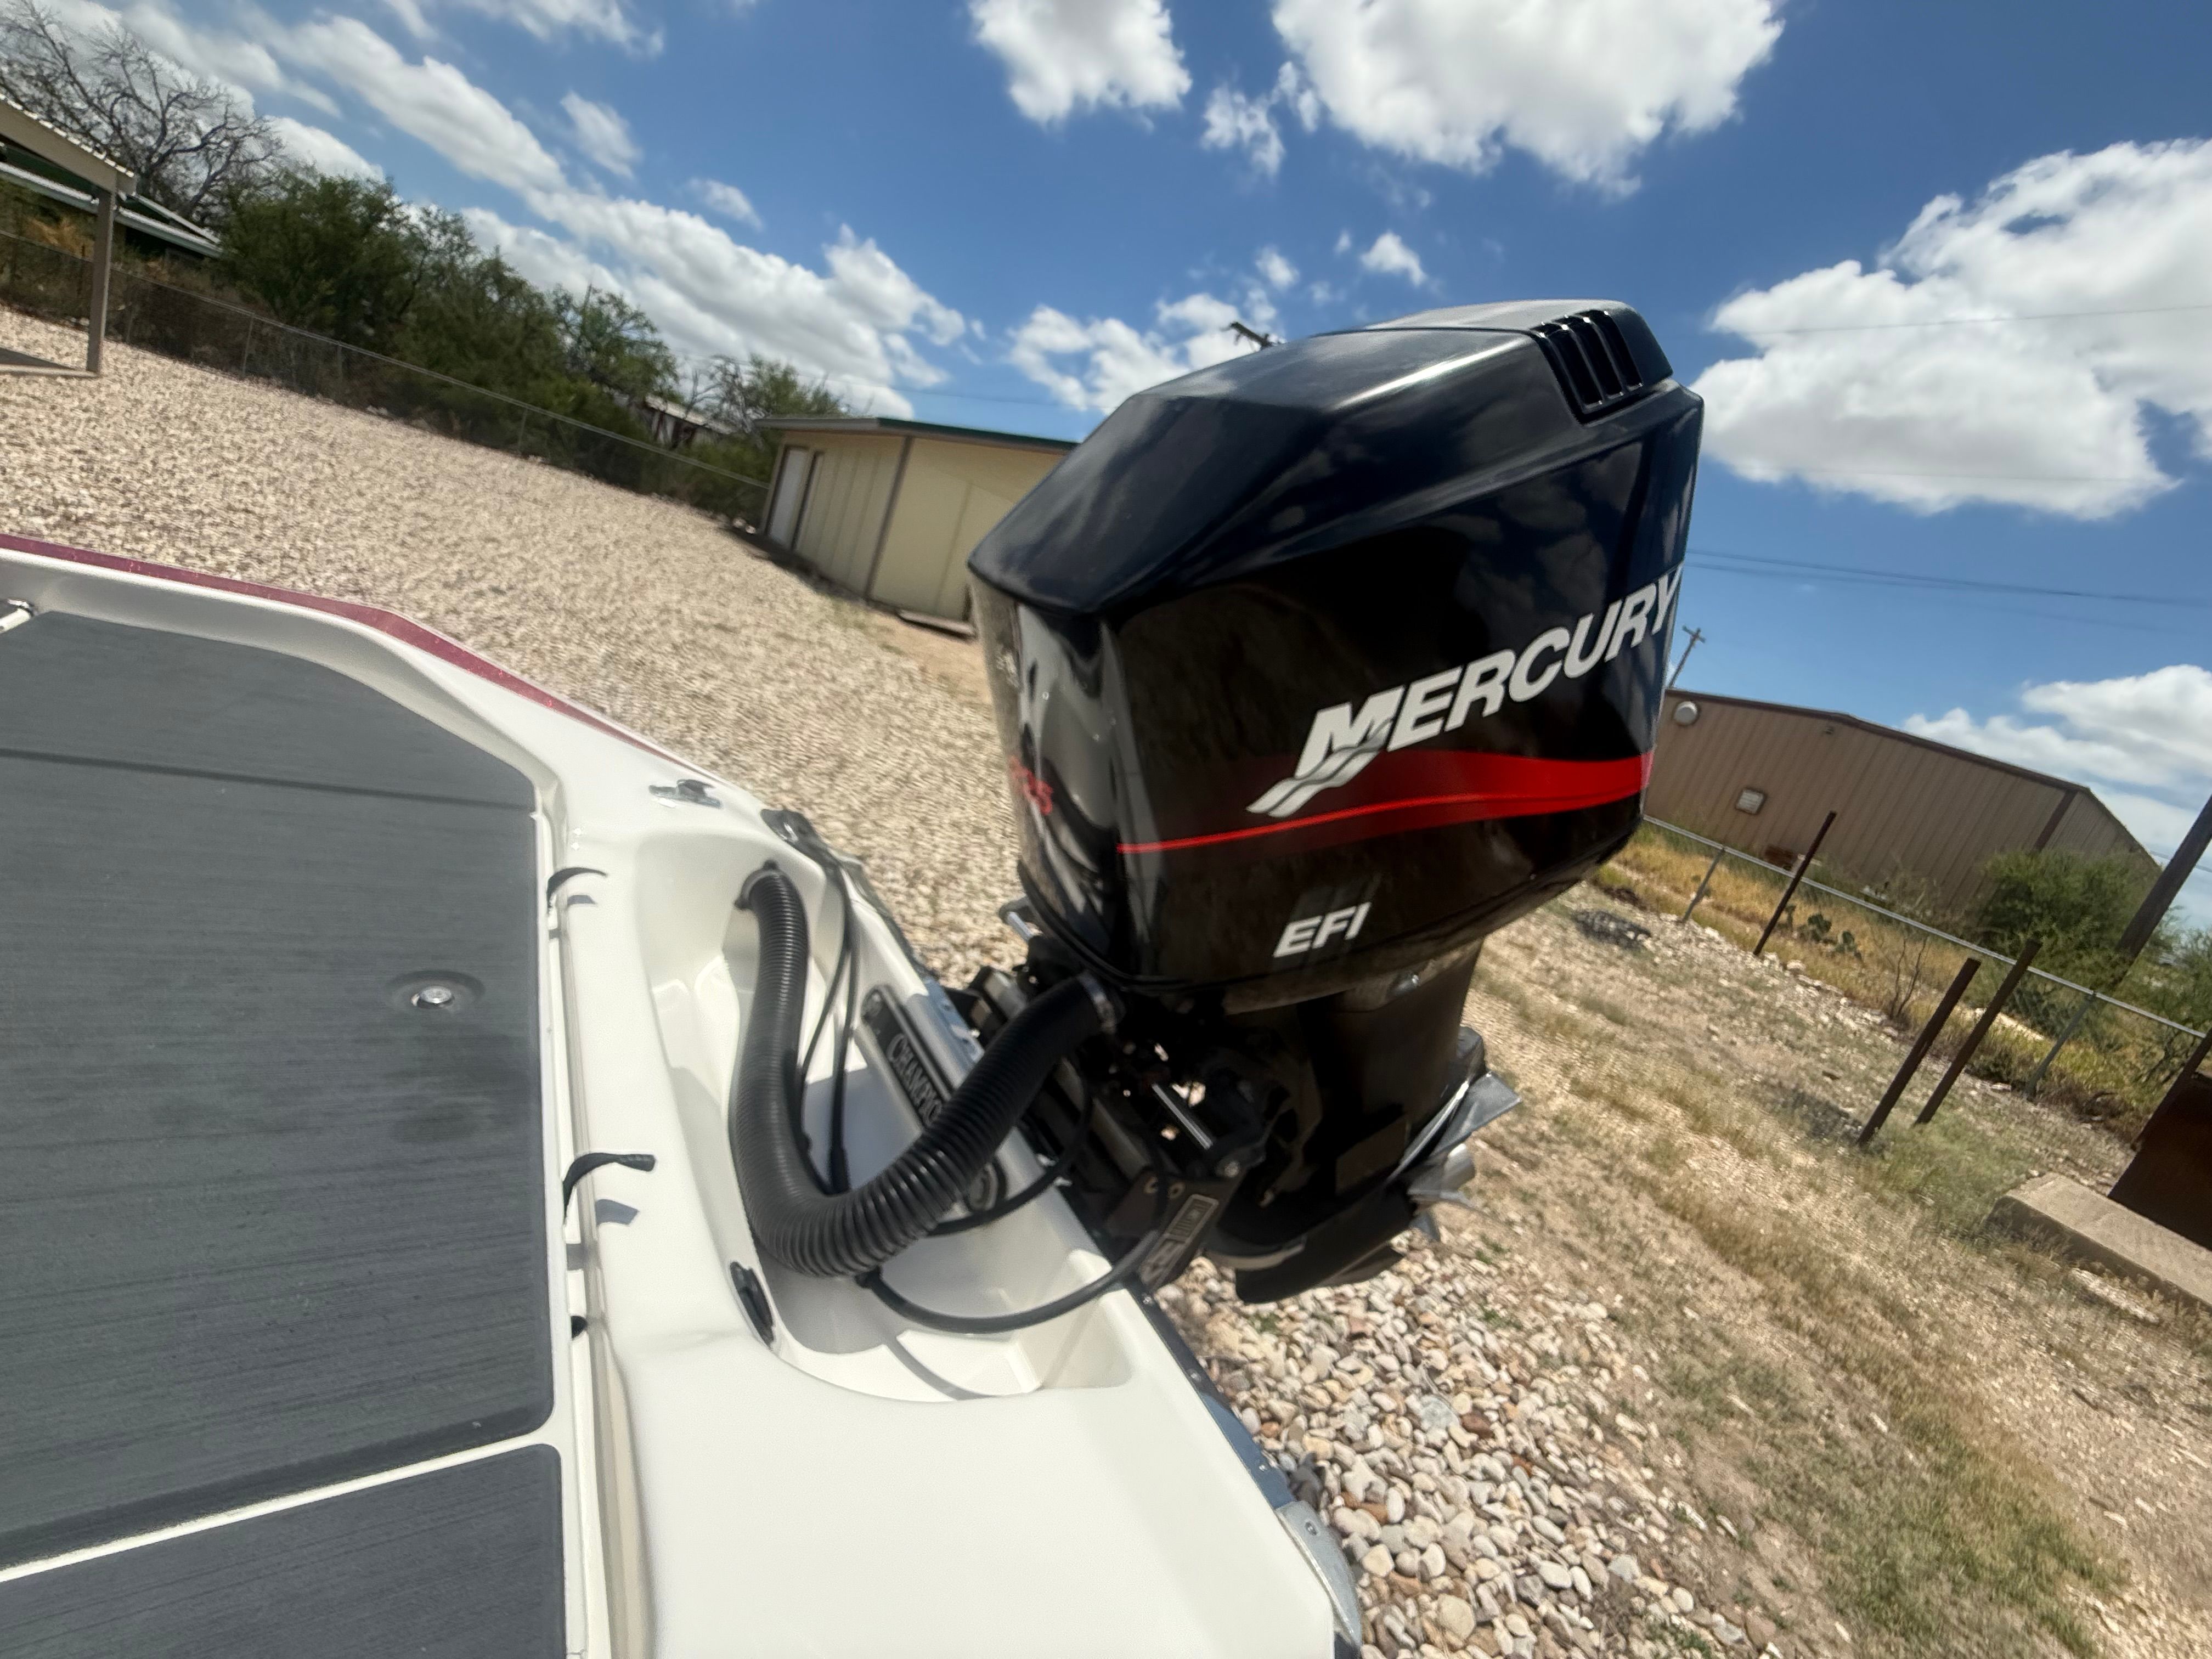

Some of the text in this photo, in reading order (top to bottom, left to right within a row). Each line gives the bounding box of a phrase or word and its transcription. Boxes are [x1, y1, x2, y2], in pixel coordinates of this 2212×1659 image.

[1293, 561, 1684, 780] MERCURY
[1272, 901, 1372, 958] EFI
[885, 1032, 945, 1129] CHAMPIO
